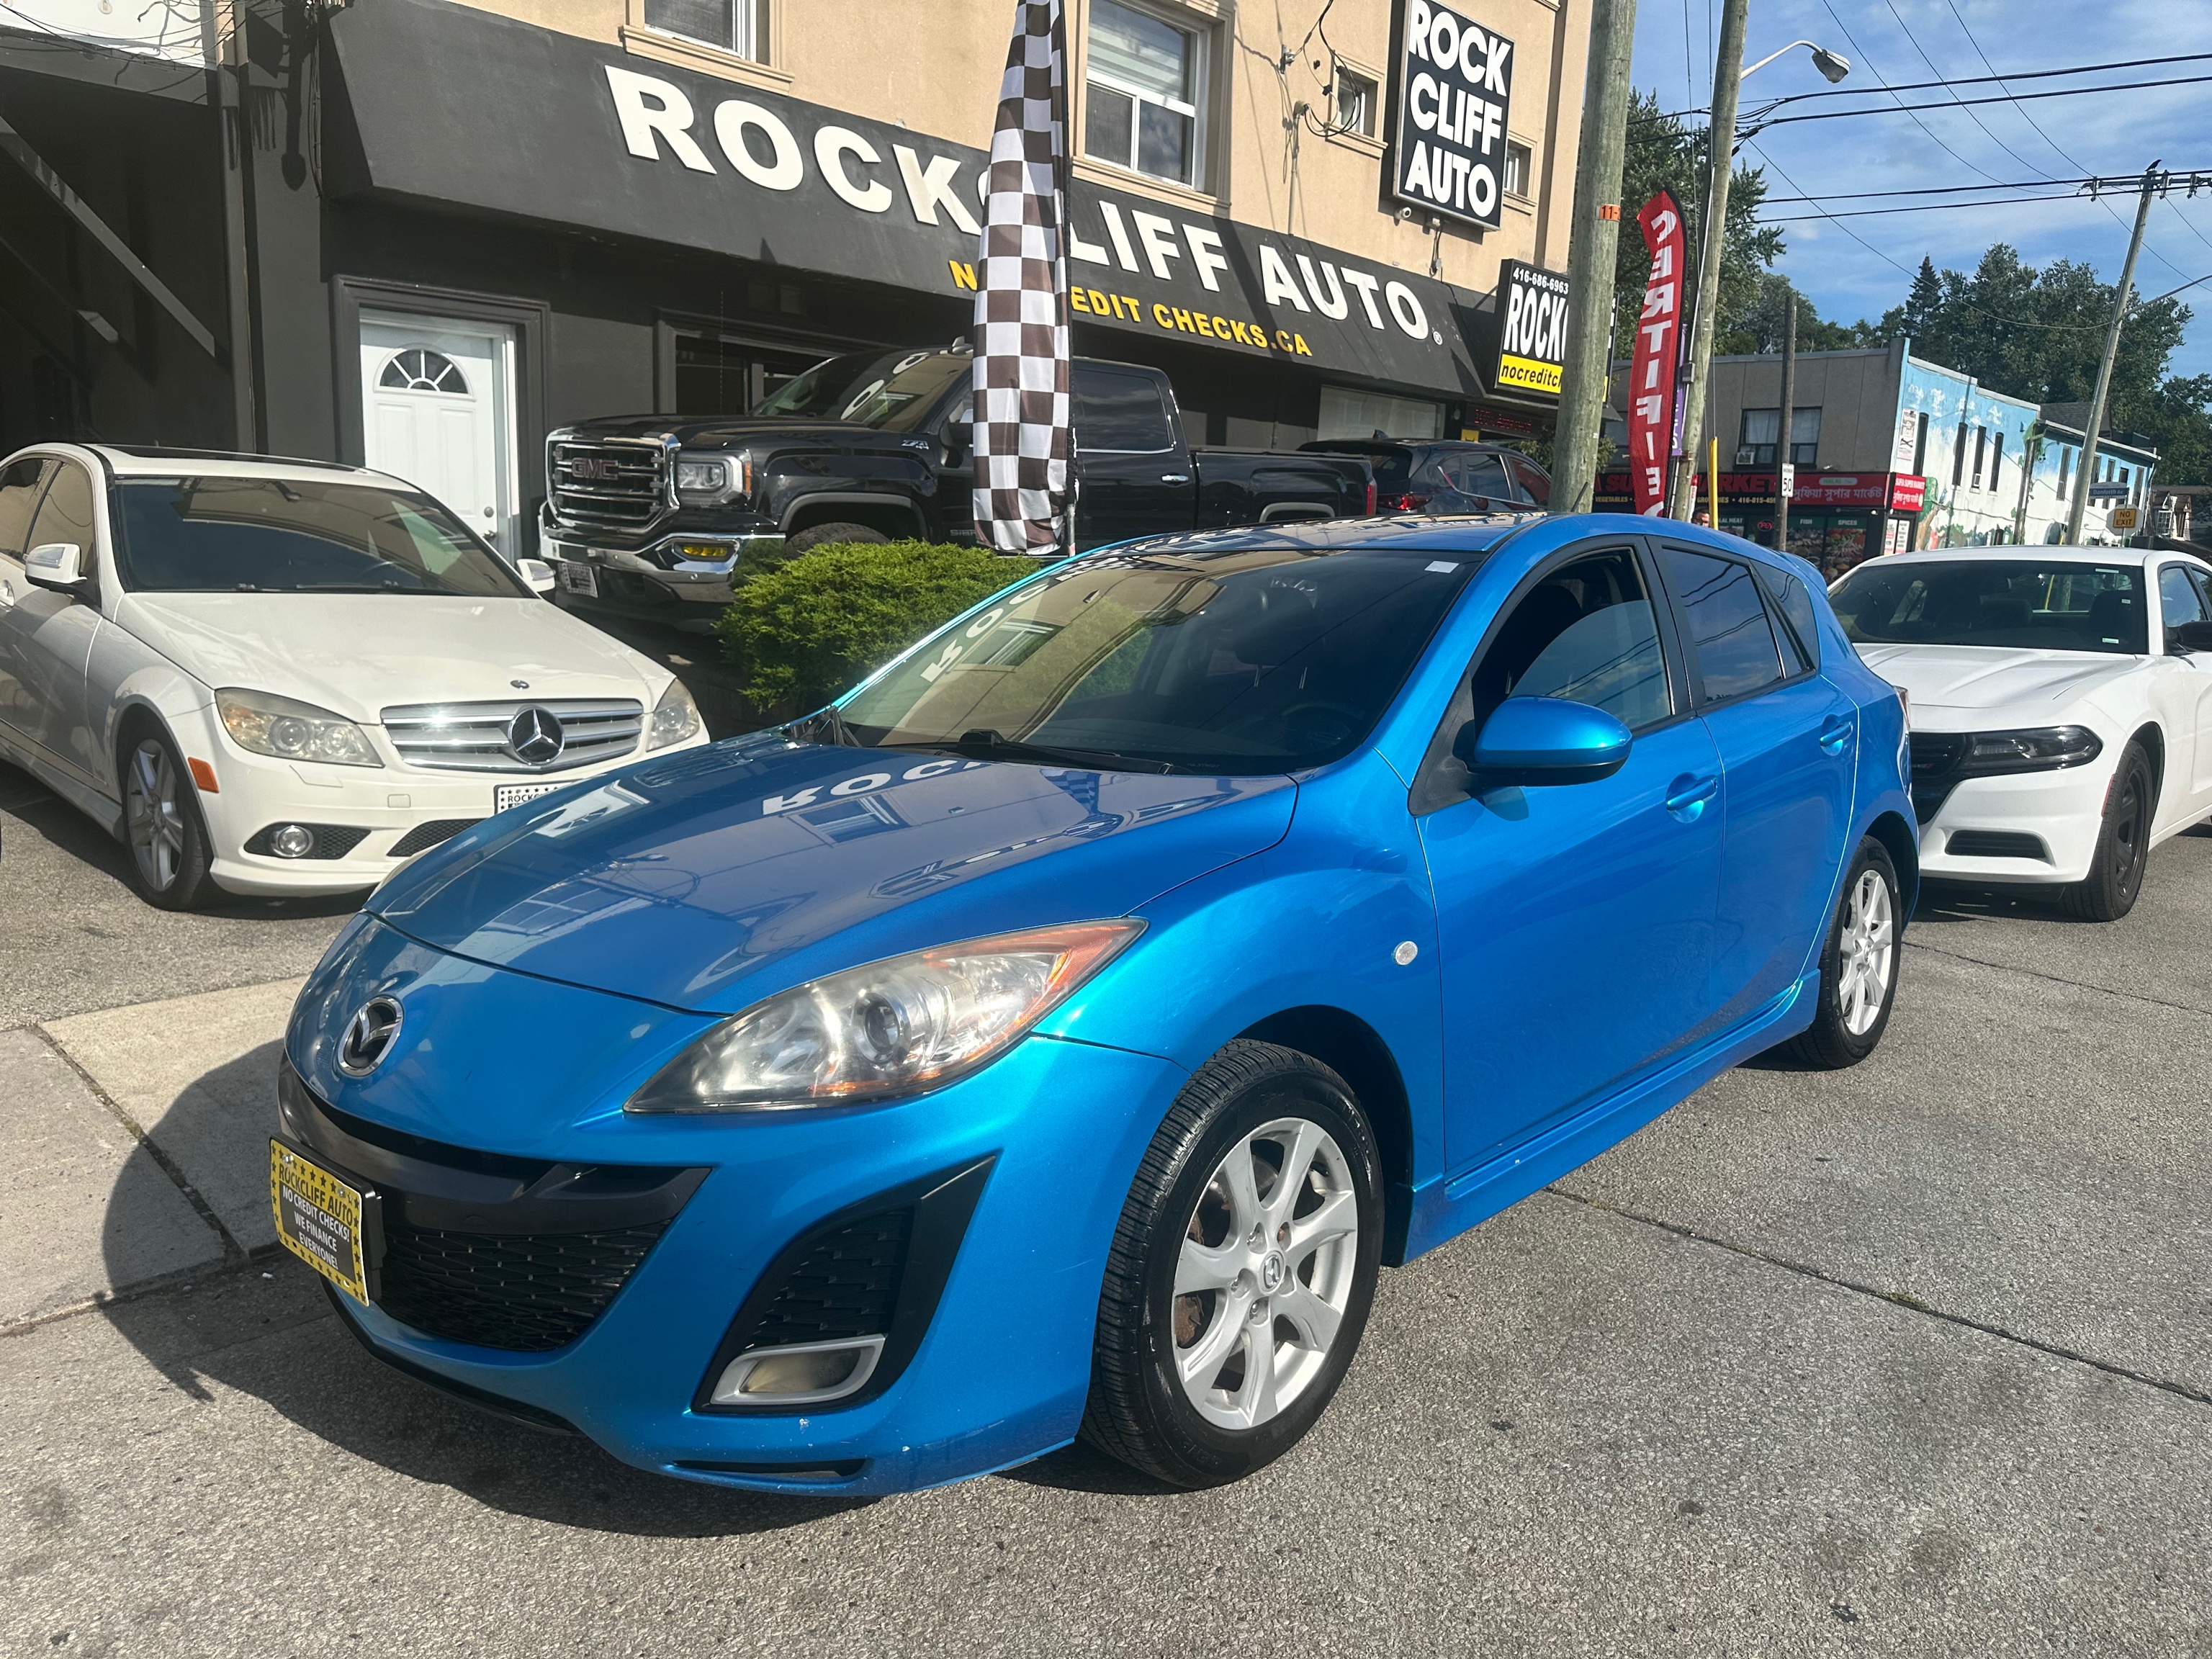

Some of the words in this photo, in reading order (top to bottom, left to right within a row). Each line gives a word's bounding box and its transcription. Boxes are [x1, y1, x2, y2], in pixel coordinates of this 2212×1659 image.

[1408, 0, 1511, 96] ROCK
[1410, 72, 1503, 156] CLIFF
[605, 65, 1228, 292] ROCKLIFF
[1404, 139, 1497, 217] AUTO
[1152, 302, 1313, 356] CHECKS.CA
[572, 457, 618, 480] GMC
[1783, 477, 1792, 492] 50
[279, 1165, 326, 1208] ROCKCLIFF
[327, 1195, 353, 1226] AUTO
[283, 1185, 293, 1202] NO
[294, 1193, 318, 1220] CREDIT
[319, 1210, 350, 1242] CHECKS!
[294, 1210, 305, 1231] WE
[306, 1220, 338, 1252] FINANCE
[299, 1231, 338, 1270] EVERYONE!
